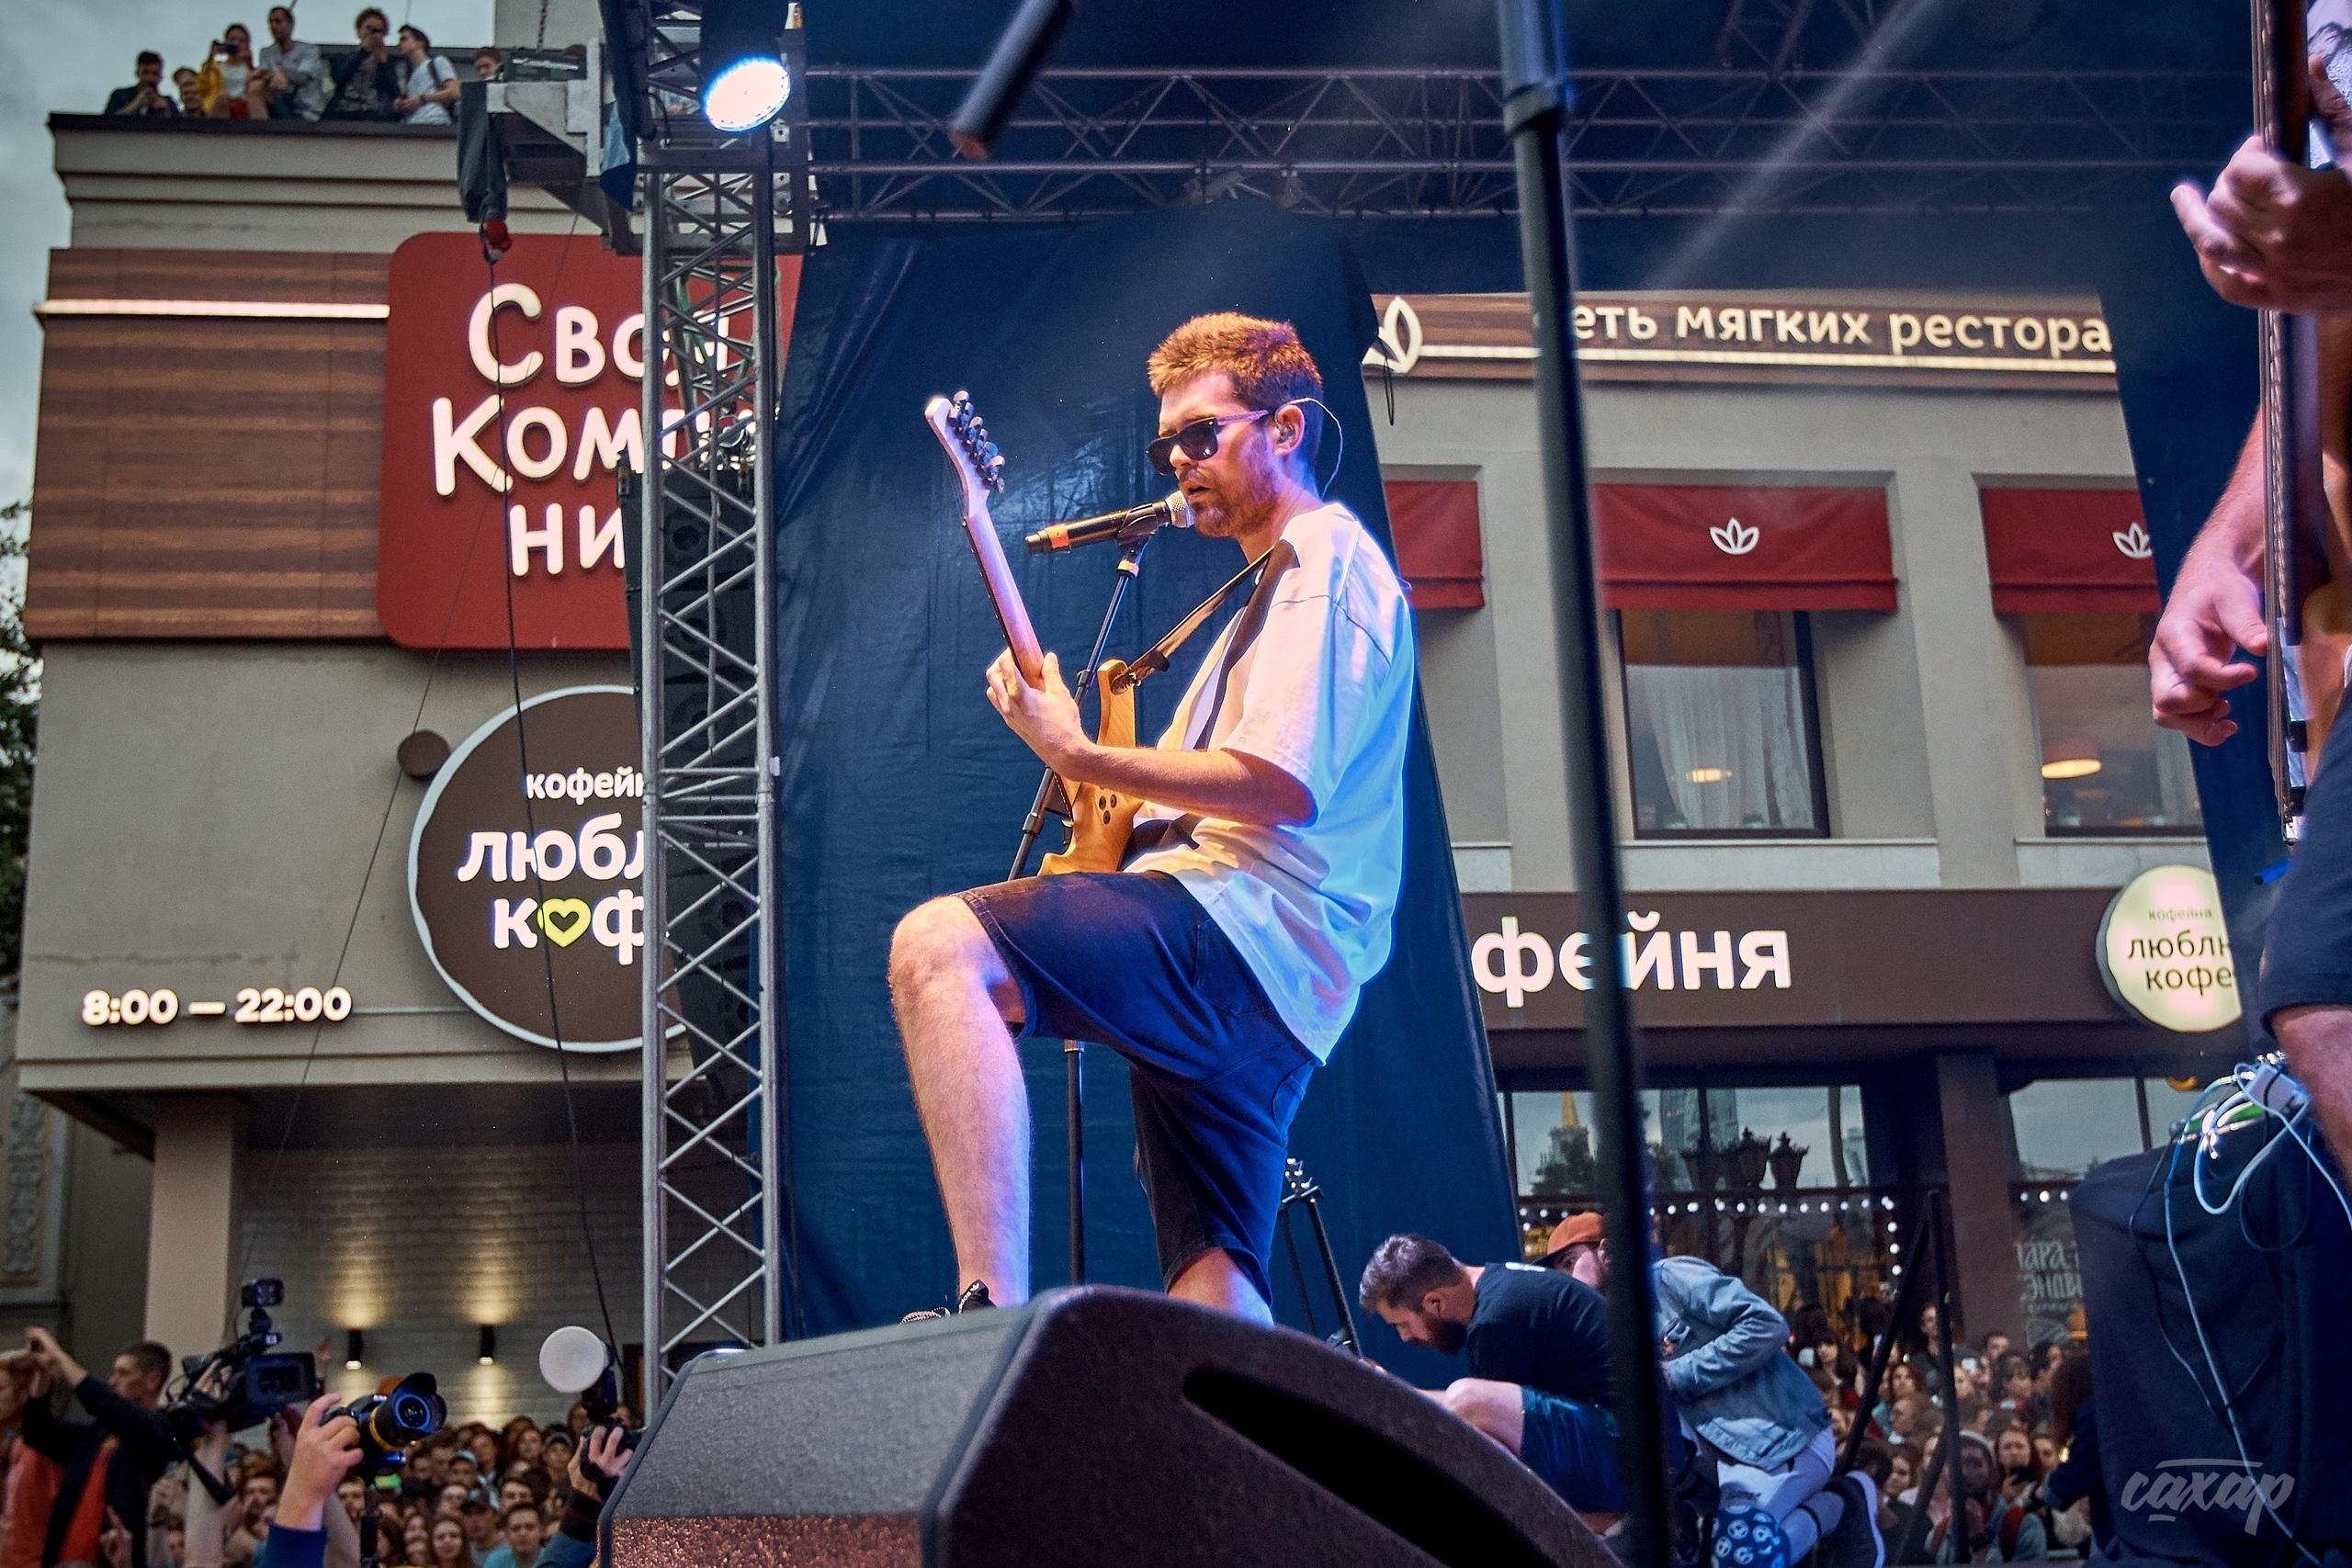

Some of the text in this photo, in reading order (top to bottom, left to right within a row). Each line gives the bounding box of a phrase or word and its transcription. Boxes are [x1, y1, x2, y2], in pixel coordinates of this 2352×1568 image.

[1532, 305, 2112, 359] еть мягких рестора
[2145, 965, 2233, 997] кофе
[82, 988, 179, 1026] 8:00
[234, 987, 353, 1022] 22:00
